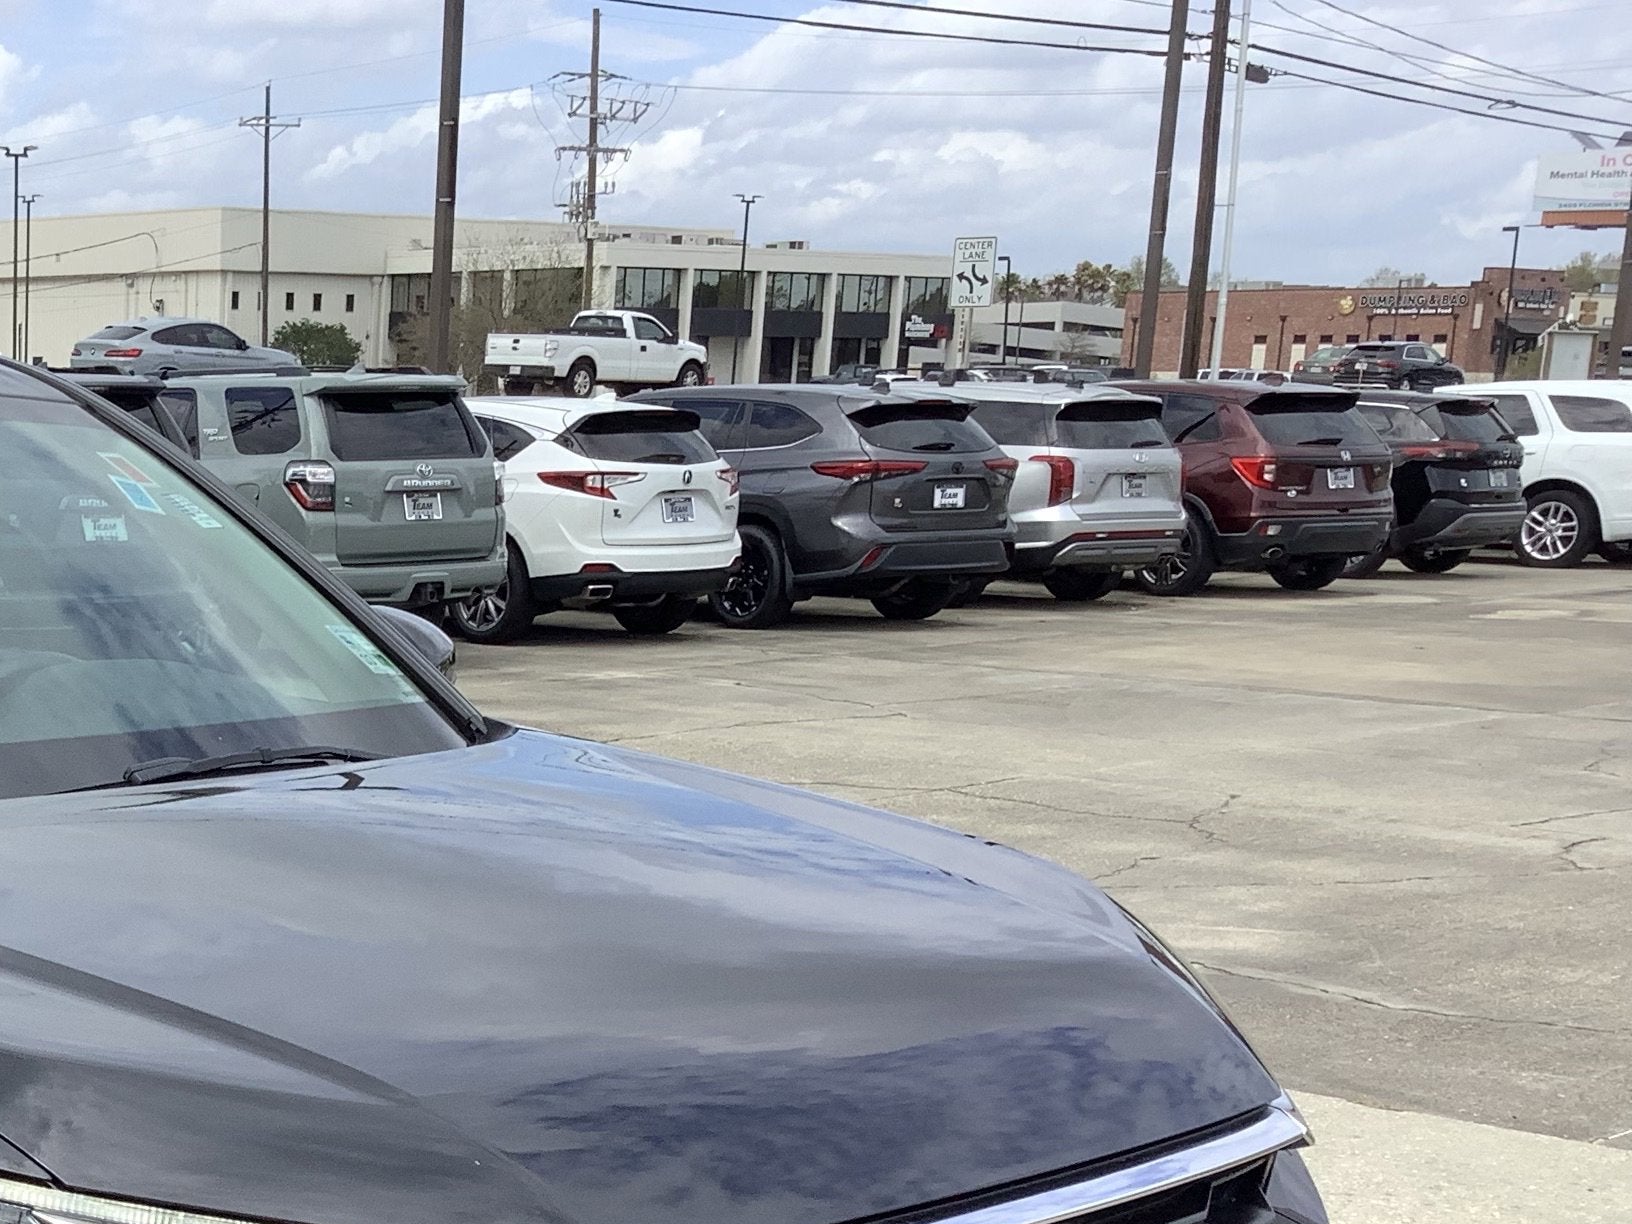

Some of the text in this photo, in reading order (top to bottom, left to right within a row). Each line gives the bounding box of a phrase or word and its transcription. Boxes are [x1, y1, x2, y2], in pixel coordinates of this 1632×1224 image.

[1600, 155, 1616, 167] In
[1550, 169, 1628, 179] Mental Health
[958, 240, 993, 250] CENTER
[962, 251, 987, 260] LANE
[958, 295, 983, 304] ONLY
[1429, 295, 1437, 306] &
[1440, 295, 1468, 306] BAO
[411, 498, 433, 511] TEAM
